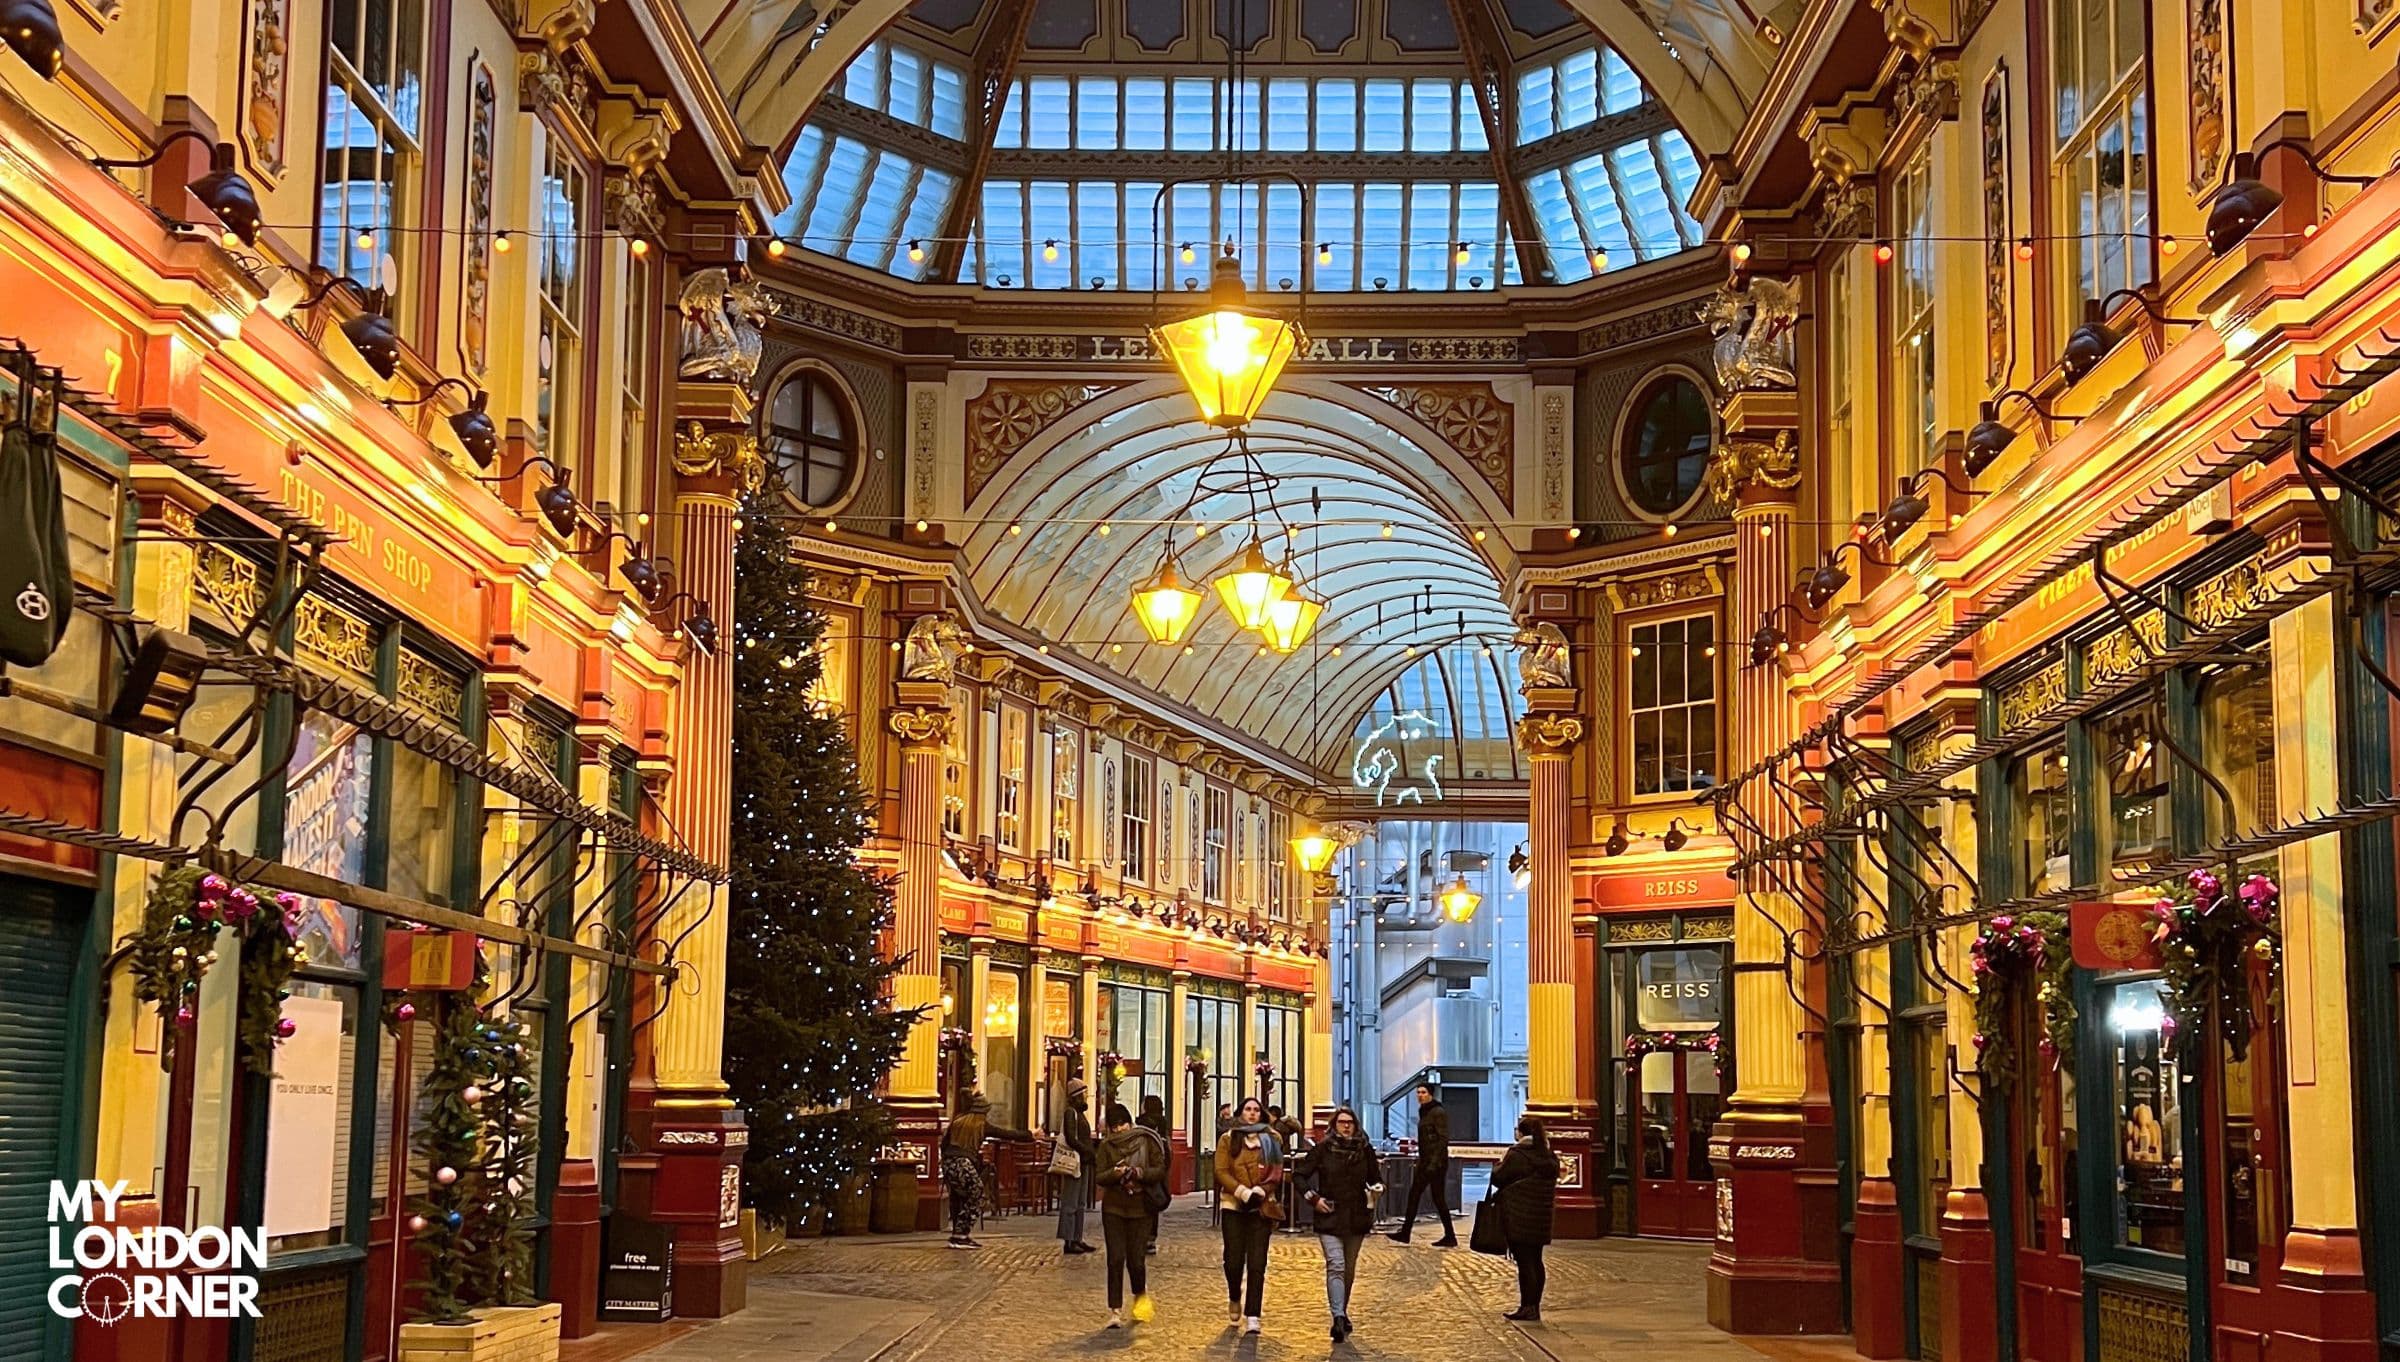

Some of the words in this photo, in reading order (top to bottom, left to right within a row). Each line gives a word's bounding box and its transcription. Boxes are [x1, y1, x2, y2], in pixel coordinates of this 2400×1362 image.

[104, 348, 122, 395] 7
[280, 467, 326, 526] THE
[333, 503, 375, 560] PEN
[383, 537, 432, 593] SHOP
[1644, 879, 1699, 897] REISS
[1646, 983, 1710, 999] REISS
[624, 1252, 647, 1263] free
[605, 1300, 624, 1308] CITY
[624, 1301, 660, 1309] MATTERS
